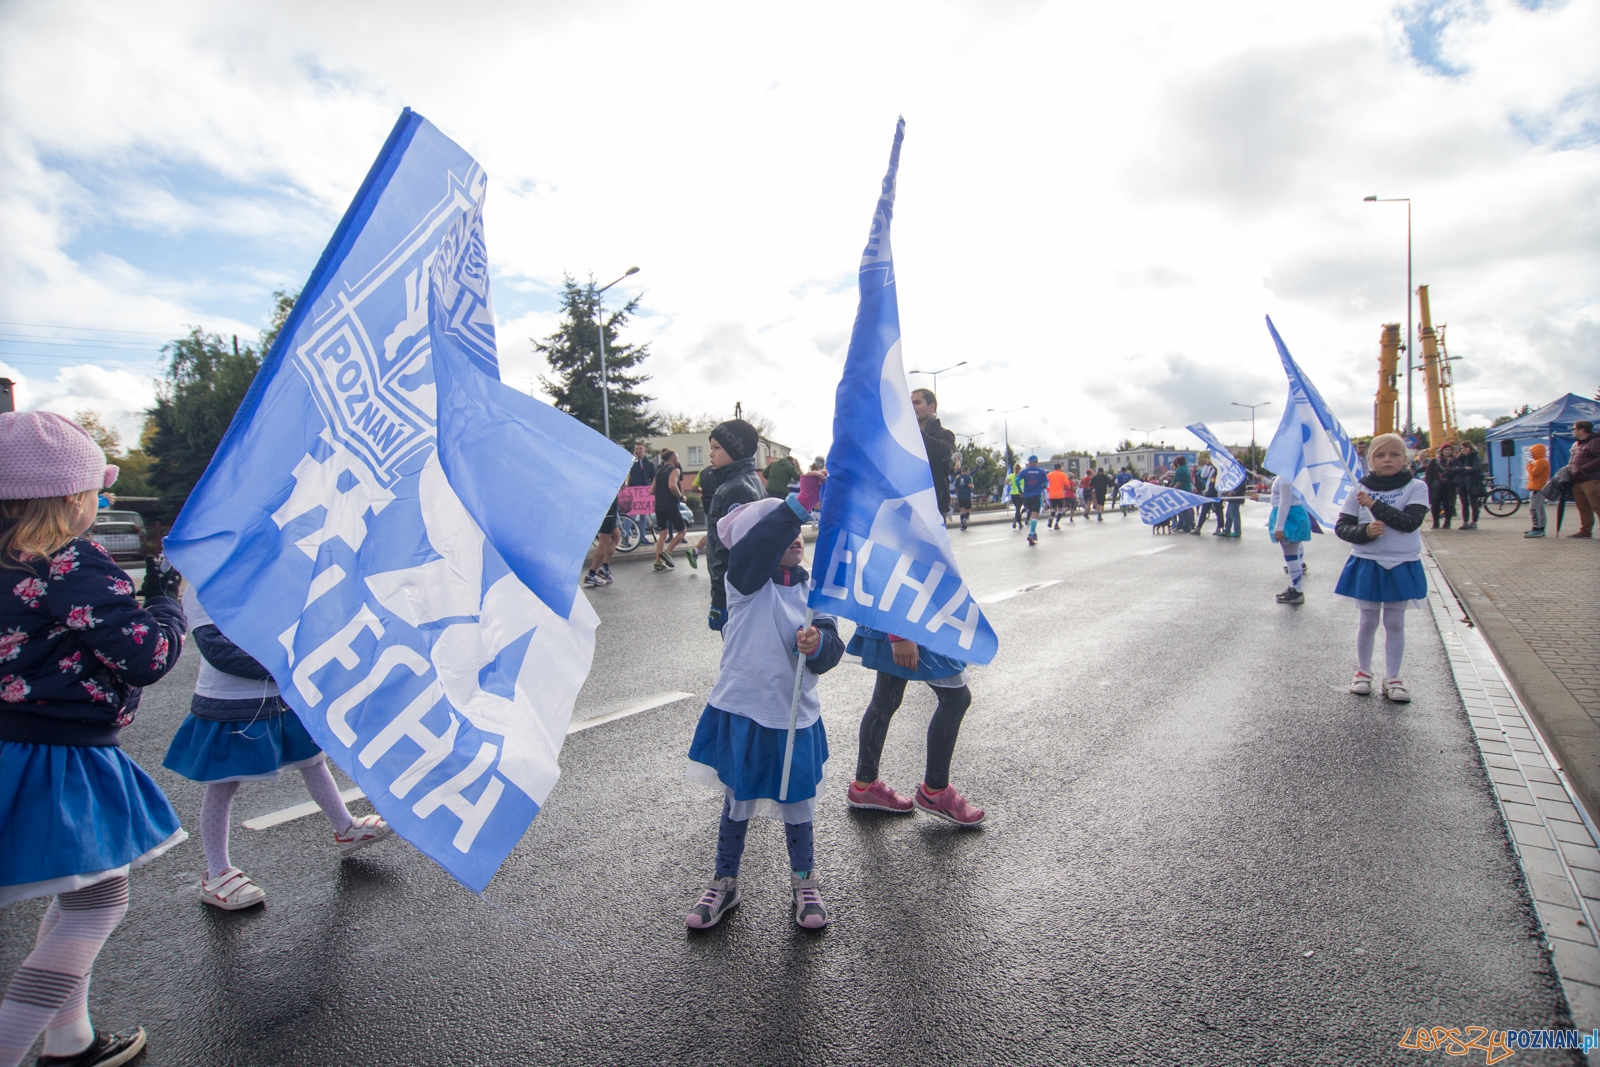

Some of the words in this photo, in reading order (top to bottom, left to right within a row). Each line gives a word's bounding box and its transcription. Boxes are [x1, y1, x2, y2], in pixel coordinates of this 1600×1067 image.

[319, 333, 407, 455] POZNAŃ
[809, 527, 980, 651] ECHA
[276, 564, 505, 855] LECHA
